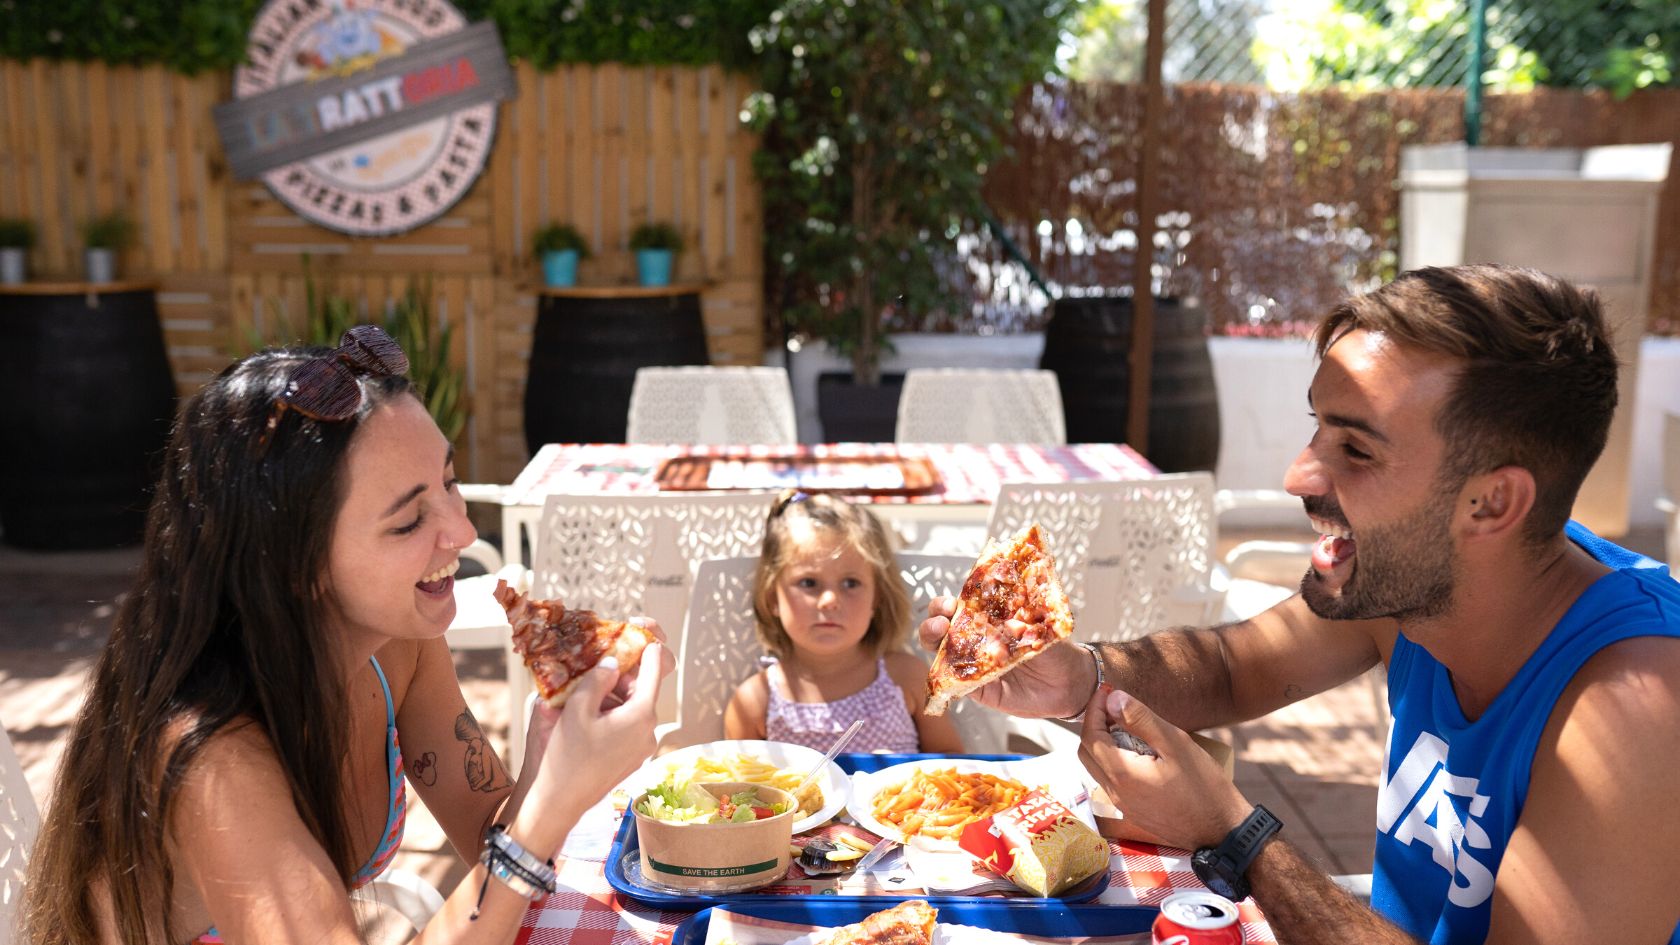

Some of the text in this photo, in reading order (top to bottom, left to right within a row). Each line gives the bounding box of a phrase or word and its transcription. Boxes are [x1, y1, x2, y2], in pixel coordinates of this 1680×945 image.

[285, 170, 384, 224] PIZZAS
[400, 196, 414, 215] &
[423, 117, 482, 198] PASTA
[1010, 802, 1066, 833] RITAS
[1376, 715, 1495, 908] VAS
[682, 867, 702, 876] SAVE
[720, 867, 745, 876] EARTH
